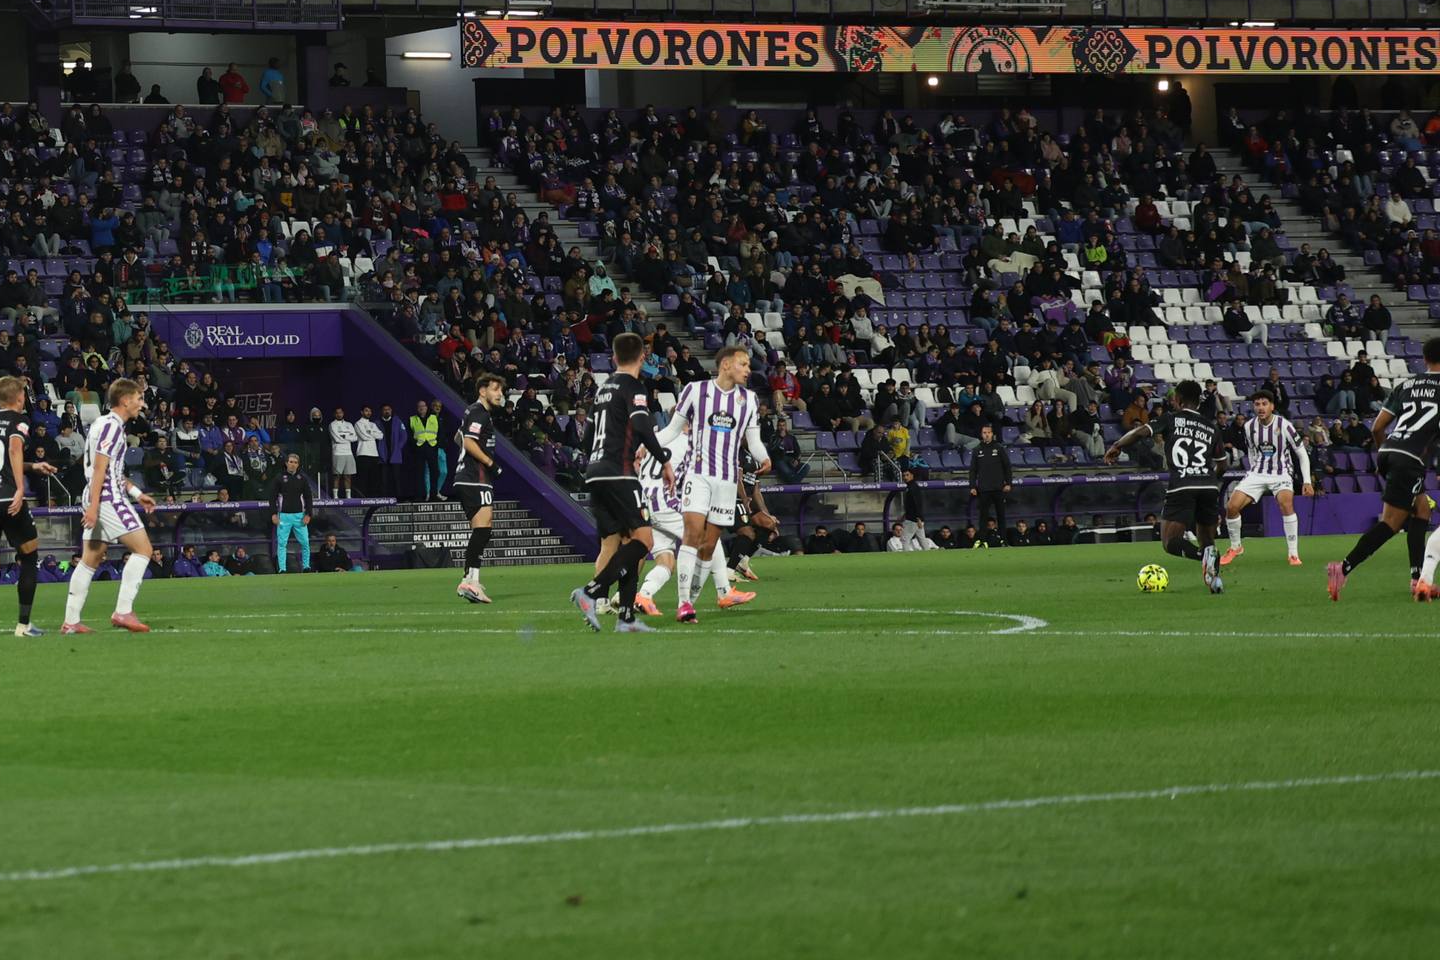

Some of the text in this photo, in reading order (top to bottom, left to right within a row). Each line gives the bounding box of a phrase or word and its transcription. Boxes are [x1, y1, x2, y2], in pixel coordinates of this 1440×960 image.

[507, 26, 819, 67] POLVORONES
[1144, 35, 1438, 70] POLVORONES
[206, 325, 244, 336] REAL
[207, 335, 300, 346] VALLADOLID
[1410, 388, 1436, 398] NIANG
[1393, 401, 1439, 432] 27
[1174, 427, 1194, 437] ALEX
[1171, 437, 1208, 468] 63
[684, 481, 692, 495] 6
[479, 490, 493, 505] 10
